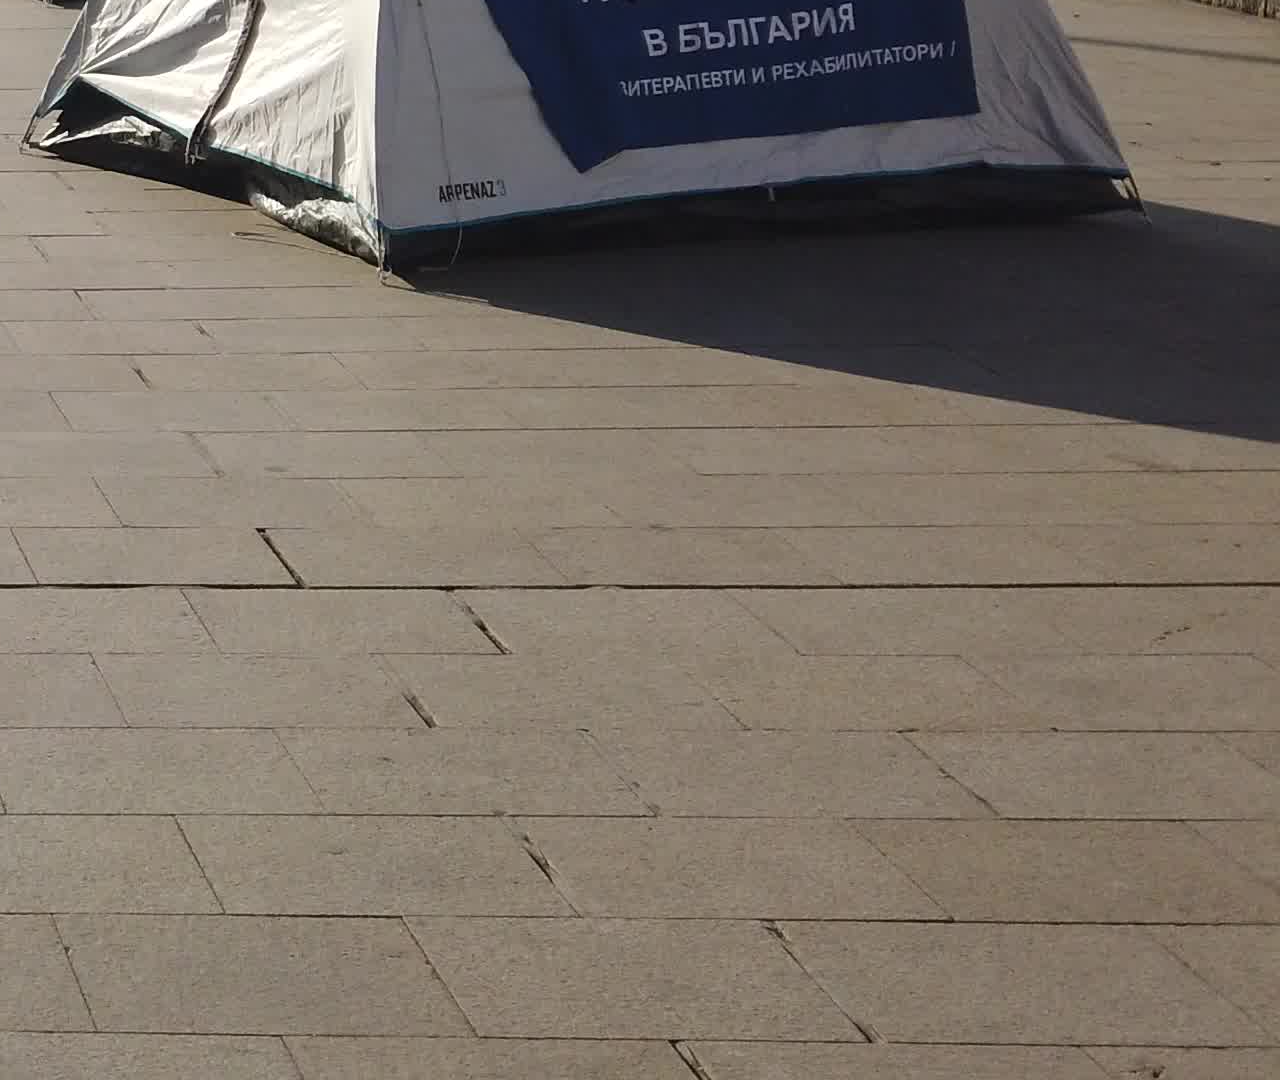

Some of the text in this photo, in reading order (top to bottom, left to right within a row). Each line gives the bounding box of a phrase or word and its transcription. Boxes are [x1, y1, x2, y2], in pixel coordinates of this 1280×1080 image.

[642, 3, 857, 58] В БЪЛГАРИЯ
[751, 64, 766, 84] И
[772, 42, 944, 83] РЕХАБИЛИТАТОРИ
[439, 180, 497, 204] ARPENAZ
